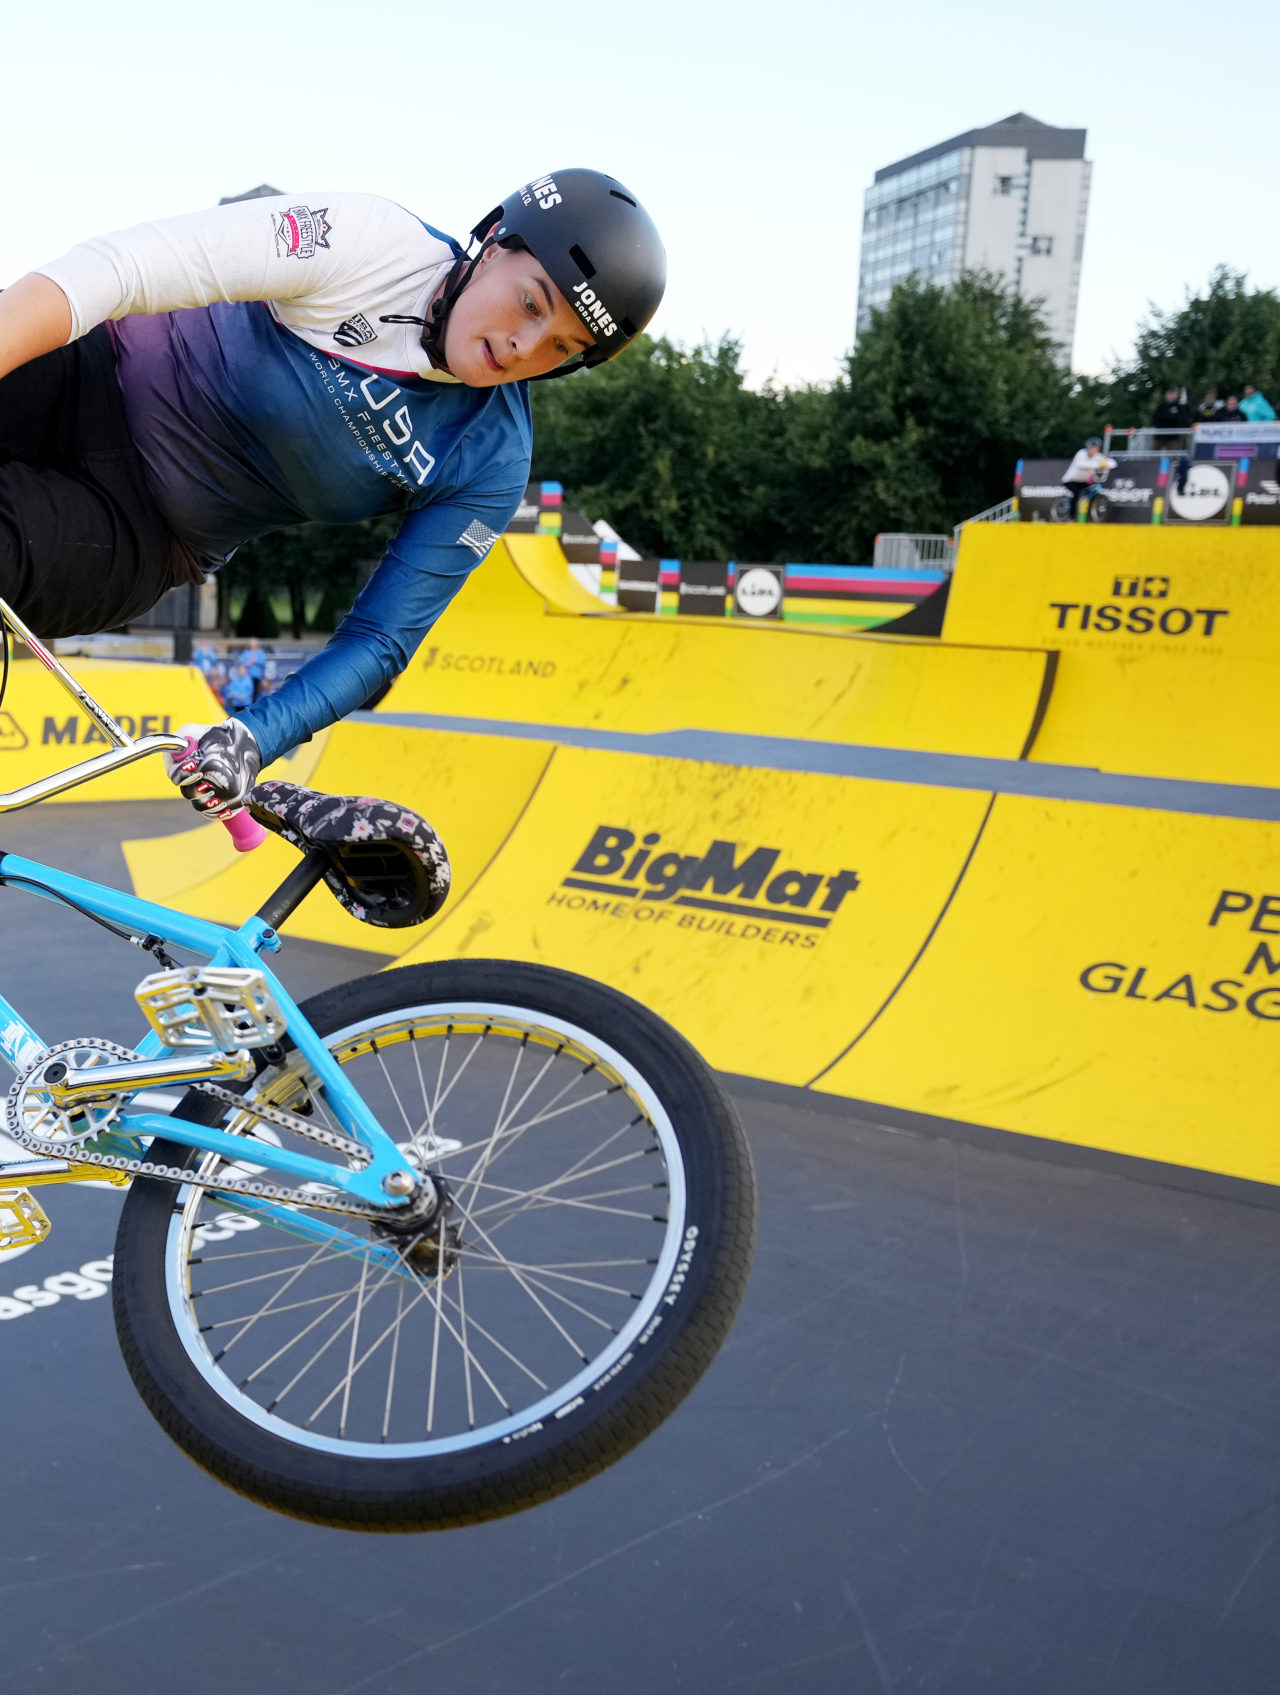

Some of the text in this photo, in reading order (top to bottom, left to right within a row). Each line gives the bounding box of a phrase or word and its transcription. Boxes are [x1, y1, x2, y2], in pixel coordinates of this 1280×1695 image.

[351, 314, 373, 339] USA
[572, 281, 618, 337] JONES
[574, 300, 599, 334] SODA CO.
[309, 352, 336, 394] WORLD
[360, 373, 436, 485] USA
[1050, 602, 1229, 637] TISSOT
[440, 653, 557, 679] SCOTLAND
[181, 760, 233, 820] FIST
[571, 825, 861, 913] BigMat
[545, 892, 820, 950] HOME OF BUILDERS
[1079, 962, 1280, 1021] GLASG
[664, 1225, 699, 1306] ODYSSEY
